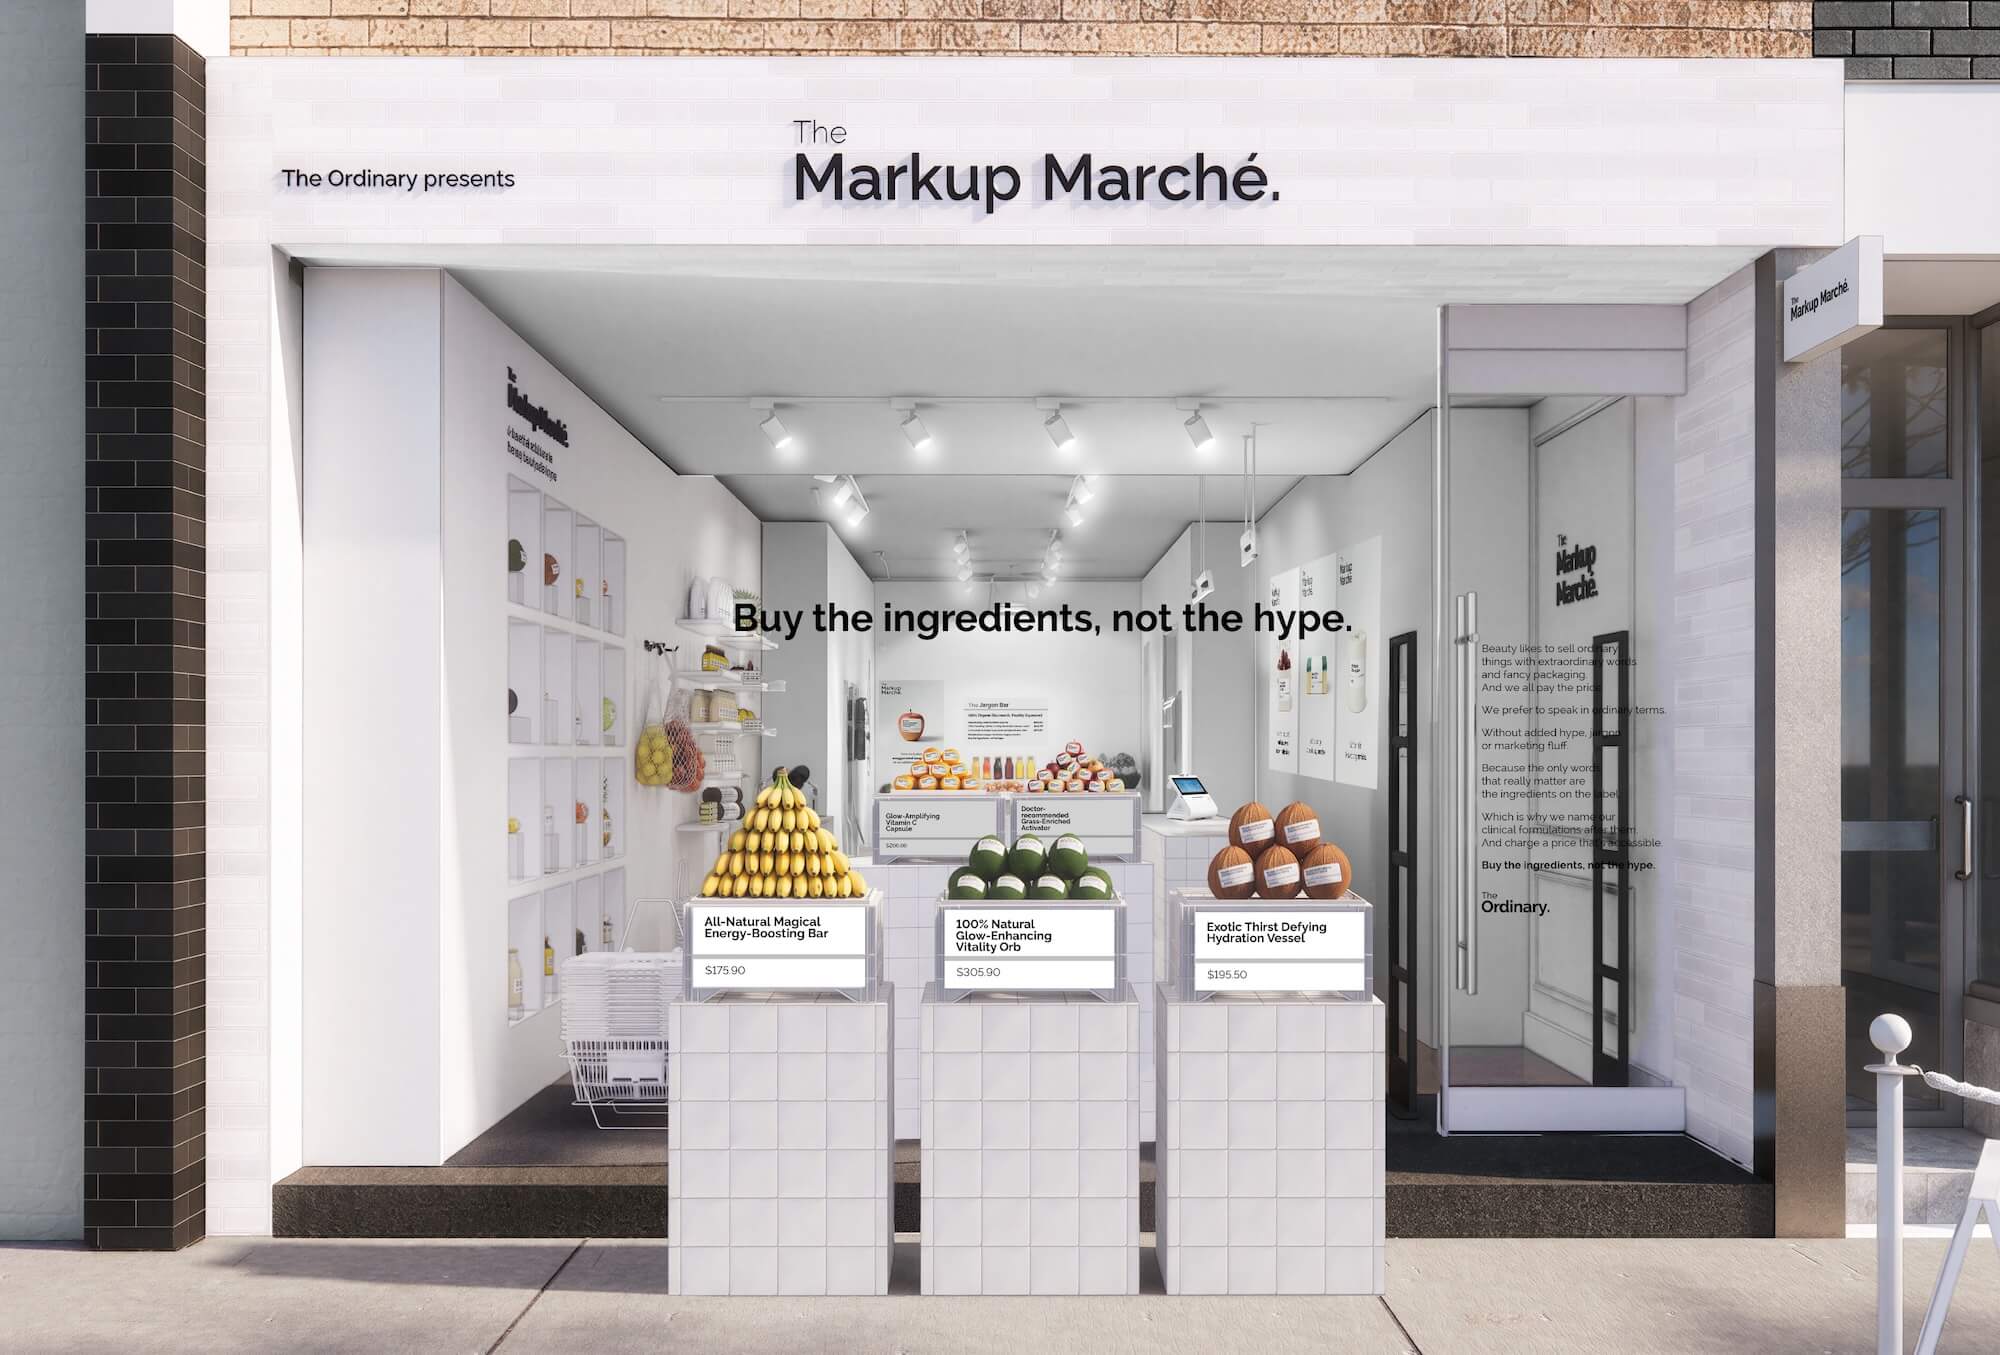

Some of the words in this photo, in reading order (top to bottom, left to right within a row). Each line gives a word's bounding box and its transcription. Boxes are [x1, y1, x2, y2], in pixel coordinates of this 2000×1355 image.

[792, 119, 847, 144] The
[281, 169, 322, 187] The
[328, 169, 418, 192] Ordinary
[425, 170, 515, 192] presents
[796, 152, 1021, 213] Markup
[1045, 152, 1279, 201] Marché.
[1790, 299, 1819, 321] Markup
[736, 603, 803, 641] Buy
[812, 602, 873, 632] the
[885, 602, 1100, 641] ingredients,
[1113, 604, 1173, 632] not
[1183, 602, 1243, 632] the
[1254, 602, 1352, 641] hype.
[1481, 644, 1517, 656] Beauty
[1520, 644, 1541, 653] likes
[1545, 645, 1555, 653] to
[1557, 644, 1575, 653] sell
[1577, 644, 1618, 656] ordary
[1481, 657, 1512, 668] things
[1515, 657, 1536, 666] with
[1481, 670, 1501, 679] and
[1503, 670, 1531, 682] fancy
[1481, 683, 1501, 692] And
[1522, 683, 1534, 692] all
[1536, 685, 1555, 695] pay
[1557, 683, 1574, 692] the
[1481, 705, 1500, 714] We
[1502, 705, 1533, 716] prefer
[1535, 706, 1545, 714] to
[1548, 705, 1578, 716] speak
[1580, 705, 1589, 714] in
[1635, 706, 1667, 715] terms.
[1481, 728, 1521, 737] Without
[1524, 728, 1556, 737] added
[1559, 728, 1587, 739] hype,
[1494, 740, 1545, 752] marketing
[1548, 740, 1568, 750] fluff.
[1481, 763, 1525, 773] Because
[1528, 763, 1544, 773] the
[1547, 763, 1567, 775] only
[1481, 776, 1500, 786] that
[1503, 776, 1531, 788] really
[1533, 777, 1566, 786] matter
[1569, 778, 1586, 786] are
[1481, 789, 1498, 799] the
[1500, 789, 1557, 800] ingredients
[1559, 791, 1573, 799] on
[1575, 789, 1592, 799] the
[885, 812, 940, 822] Glow-Amplifying
[1481, 812, 1514, 822] Which
[1516, 812, 1524, 822] is
[1527, 812, 1547, 825] why
[1550, 814, 1565, 822] we
[1568, 814, 1597, 822] name
[885, 825, 913, 833] Capsule
[1481, 825, 1516, 834] clinical
[1518, 825, 1582, 834] formulations
[1481, 838, 1501, 848] And
[1504, 838, 1540, 850] charge
[1542, 840, 1549, 848] a
[1551, 838, 1576, 850] price
[1608, 838, 1664, 848] acessible.
[1481, 861, 1501, 872] Buy
[1504, 861, 1521, 870] the
[1523, 861, 1585, 872] ingredients,
[1588, 861, 1605, 870] not
[1608, 861, 1624, 870] the
[1626, 861, 1656, 872] hype.
[1481, 891, 1498, 900] The
[1481, 900, 1551, 916] Ordinary.
[704, 916, 770, 927] All-Natural
[774, 916, 821, 928] Magical
[956, 919, 989, 929] 100%
[991, 919, 1036, 929] Natural
[1207, 922, 1242, 932] Exotic
[1244, 922, 1279, 932] Thirst
[1281, 922, 1327, 934] Defying
[704, 928, 805, 940] Energy-Boosting
[808, 928, 829, 938] Bar
[956, 931, 1052, 942] Glow-Enhancing
[1207, 933, 1265, 946] Hydration
[1267, 933, 1307, 943] Vessel
[956, 942, 997, 954] Vitality
[999, 942, 1021, 952] Orb
[705, 965, 746, 976] $175.90
[956, 967, 1001, 977] $305.90
[1207, 969, 1248, 980] $195.50
